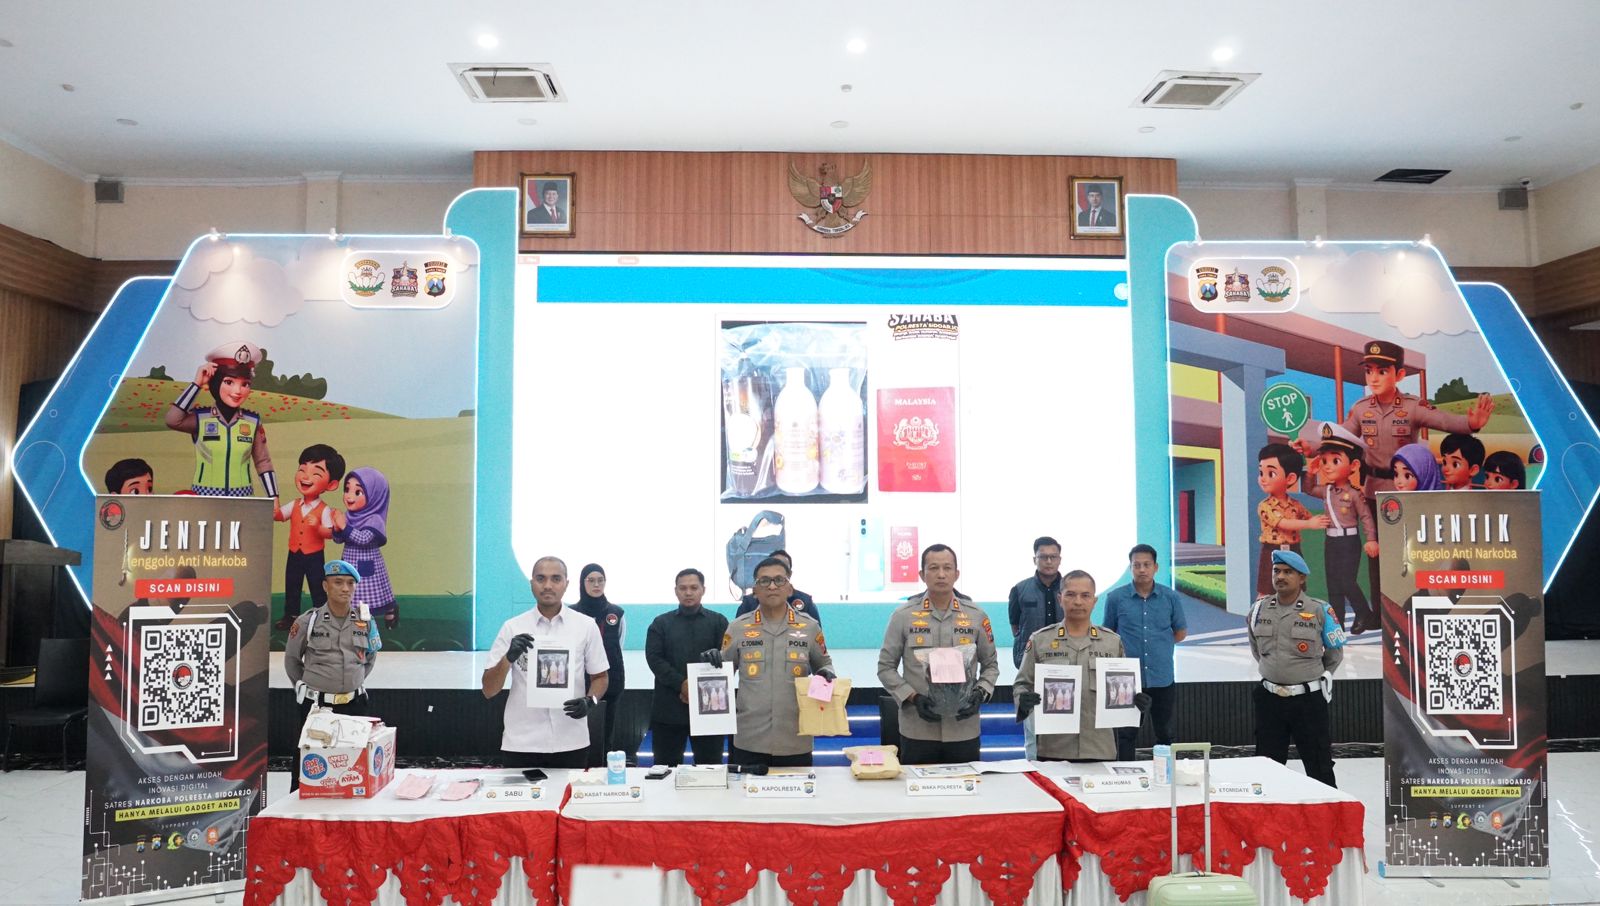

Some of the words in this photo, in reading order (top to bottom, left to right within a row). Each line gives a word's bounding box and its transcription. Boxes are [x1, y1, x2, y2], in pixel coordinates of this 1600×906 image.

[894, 398, 937, 406] MALAYSIA
[1266, 392, 1298, 411] STOP
[1416, 513, 1510, 543] JENTIK
[139, 519, 242, 551] JENTIK
[1452, 547, 1473, 560] Anti
[1475, 547, 1517, 560] Narkoba
[178, 554, 201, 568] Anti
[203, 554, 247, 568] Narkoba
[1428, 575, 1457, 584] SCAN
[1460, 574, 1493, 584] DISINI
[149, 583, 181, 593] SCAN
[185, 582, 220, 593] DISINI
[1294, 620, 1316, 630] POLRI
[953, 627, 974, 635] POLRI
[788, 640, 808, 648] POLRI
[1428, 757, 1449, 765] AKSES
[1451, 757, 1478, 765] DENGAN
[1480, 757, 1504, 765] MUDAH
[1437, 767, 1464, 775] INOVASI
[1466, 767, 1491, 775] DIGITAL
[138, 777, 161, 785] AKSES
[164, 773, 194, 783] DENGAN
[197, 771, 222, 779] MUDAH
[341, 774, 360, 783] AYAM
[1400, 777, 1425, 785] SATRES
[1427, 777, 1459, 785] NARKOBA
[1461, 777, 1495, 785] POLRESTA
[1497, 777, 1532, 786] SIDOARJO
[148, 785, 179, 794] INOVASI
[181, 783, 208, 792] DIGITAL
[1413, 788, 1437, 796] HANYA
[1439, 788, 1469, 796] MELALUI
[1471, 788, 1498, 796] GADGET
[1501, 788, 1520, 796] ANDA
[104, 800, 132, 809] SATRES
[135, 796, 172, 806] NARKOBA
[174, 793, 212, 803] POLRESTA
[214, 788, 252, 799] SIDOARJO
[118, 810, 146, 819] HANYA
[148, 807, 182, 816] MELALUI
[185, 803, 215, 813] GADGET
[218, 800, 238, 809] ANDA
